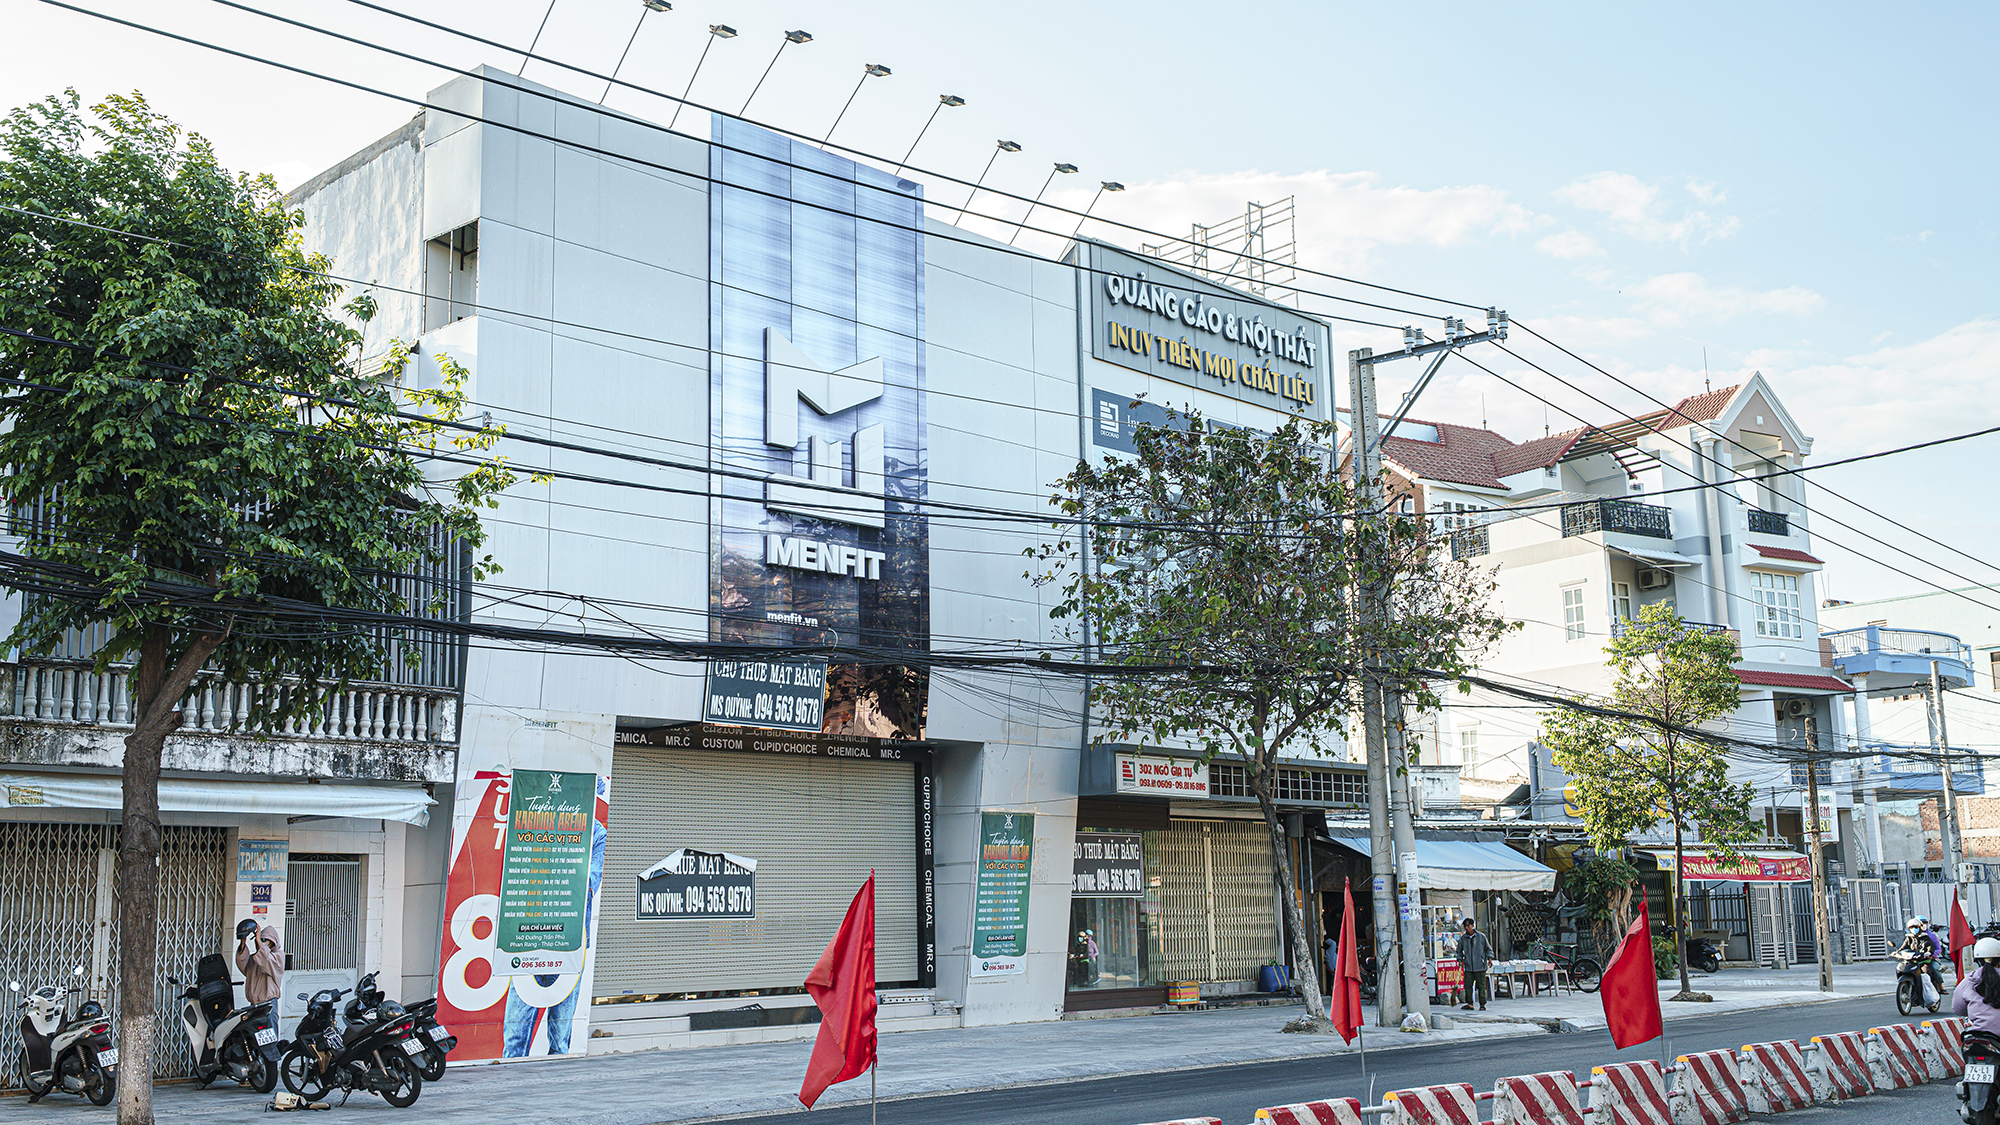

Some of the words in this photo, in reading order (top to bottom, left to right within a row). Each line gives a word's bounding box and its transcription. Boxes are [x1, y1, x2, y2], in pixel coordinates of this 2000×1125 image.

[1106, 270, 1179, 320] QUẢNG
[1181, 293, 1221, 334] CÁO
[1223, 312, 1239, 342] &
[1239, 314, 1272, 357] NỘI
[1272, 325, 1317, 368] THẤT
[1155, 336, 1201, 371] TRÊN
[1202, 350, 1236, 387] MỌI
[1240, 359, 1280, 395] CHẤT
[1281, 371, 1315, 409] LIỆU
[764, 533, 886, 581] MENFIT
[766, 612, 819, 628] menfit.vn
[714, 660, 737, 679] CHO
[710, 695, 724, 716] MS
[724, 692, 753, 719] QUỲNH:
[754, 692, 774, 720] 094
[774, 694, 794, 722] 563
[795, 696, 819, 725] 9678
[615, 732, 653, 745] EMICA
[665, 735, 691, 747] MR.C
[702, 737, 743, 749] CUSTOM
[753, 740, 818, 754] CUPID'CHOICE
[827, 745, 871, 758] CHEMICAL
[880, 749, 901, 759] MR.C
[1139, 763, 1152, 775] 302
[1154, 764, 1169, 776] NGÔ
[514, 810, 556, 830] KARINOX
[558, 812, 588, 832] ARENA
[922, 775, 932, 856] CUPID'CHOICE
[1805, 819, 1831, 832] SRI
[517, 831, 534, 843] VỚI
[535, 831, 555, 843] CÁC
[556, 834, 566, 846] VỊ
[567, 832, 582, 843] TRÍ
[1083, 838, 1103, 860] THUÊ
[1120, 837, 1140, 860] BẰNG
[240, 851, 267, 871] TRUNG
[268, 852, 287, 871] NAM
[252, 886, 270, 896] 304
[1096, 868, 1110, 891] 094
[1110, 868, 1124, 891] 563
[1124, 868, 1141, 891] 9678
[641, 892, 654, 913] MS
[655, 888, 684, 915] QUỲNH:
[686, 885, 705, 913] 094
[706, 885, 726, 913] 563
[727, 885, 752, 913] 9678
[924, 869, 933, 929] CHEMICAL
[926, 943, 934, 974] MR.C
